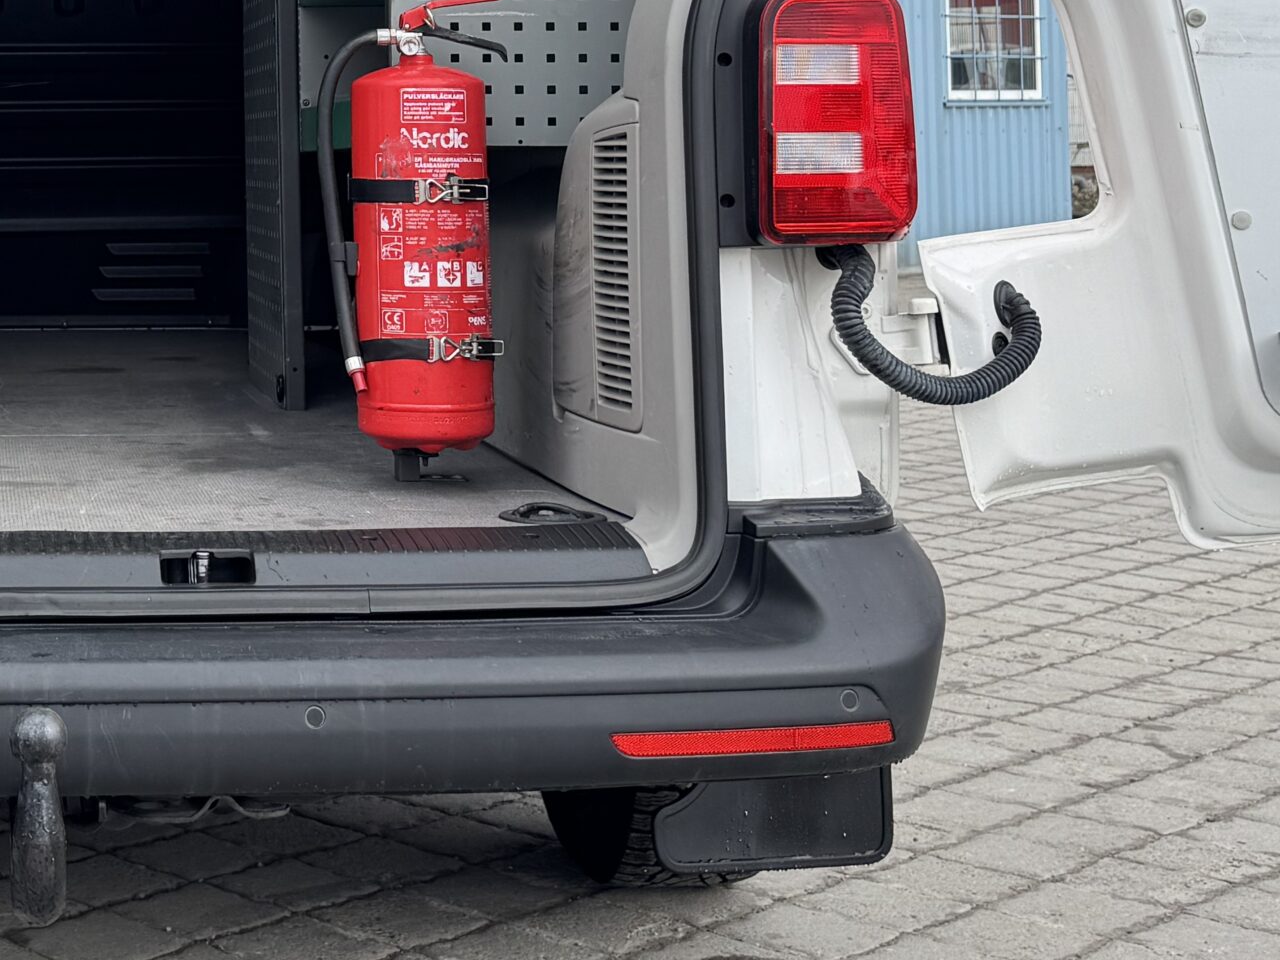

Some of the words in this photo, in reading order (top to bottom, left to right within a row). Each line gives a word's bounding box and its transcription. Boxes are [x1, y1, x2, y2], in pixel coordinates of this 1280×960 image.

[400, 127, 469, 149] Nordic
[421, 263, 429, 271] A
[384, 312, 401, 325] CE
